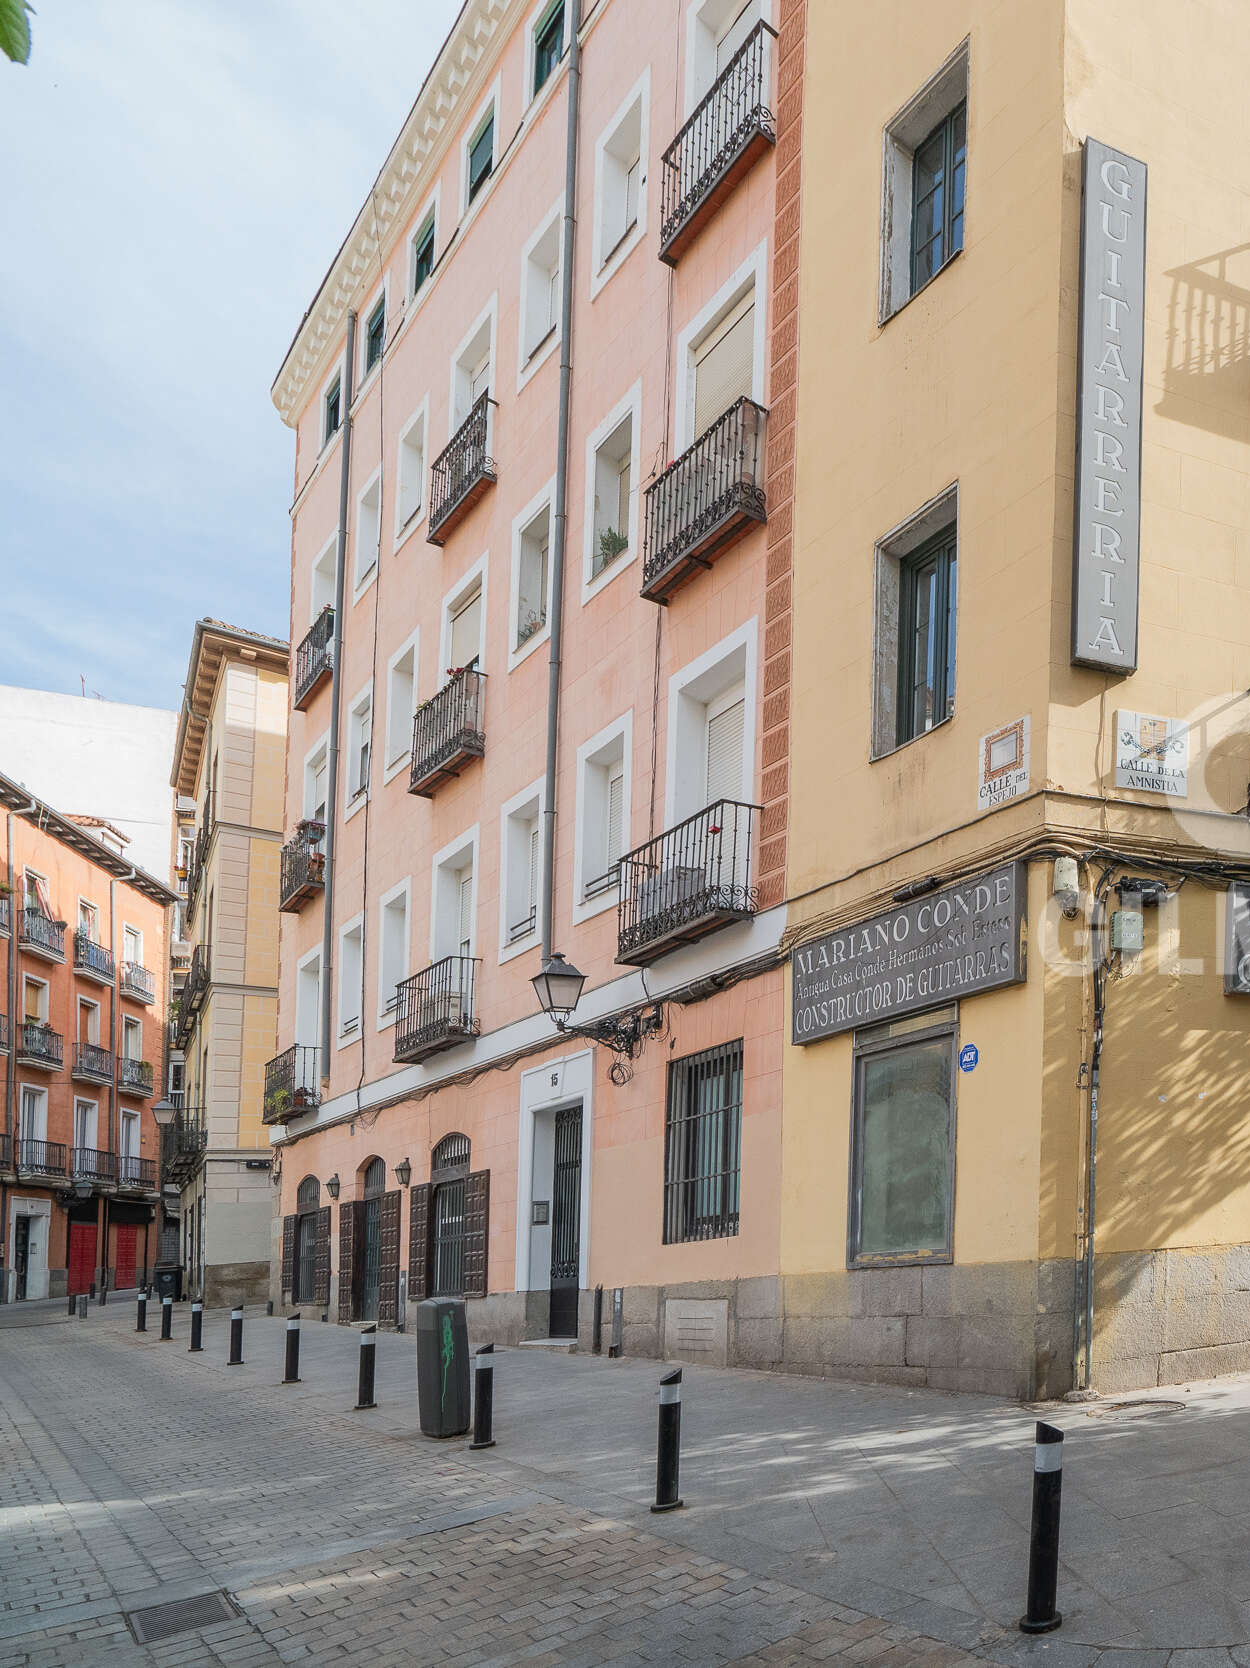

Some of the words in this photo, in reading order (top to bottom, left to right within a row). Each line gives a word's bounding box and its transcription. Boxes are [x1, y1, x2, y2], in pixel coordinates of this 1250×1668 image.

[1088, 160, 1132, 655] GUITARRERIA
[1120, 759, 1152, 774] CALLE
[980, 775, 1011, 798] CALLE
[1015, 772, 1027, 783] DEL
[989, 785, 1017, 806] ESPEJO
[1127, 775, 1178, 793] AMNISTIA
[796, 915, 910, 978] MARIANO
[917, 876, 1011, 933] CONDE
[797, 979, 830, 1001] Antigua
[832, 970, 853, 988] Casa
[855, 956, 887, 981] Conde
[888, 939, 944, 970] Hermanos
[796, 981, 892, 1034] CONSTRUCTOR
[896, 973, 915, 1004] DE
[918, 941, 1010, 996] GUITARRAS
[551, 1073, 558, 1087] 15
